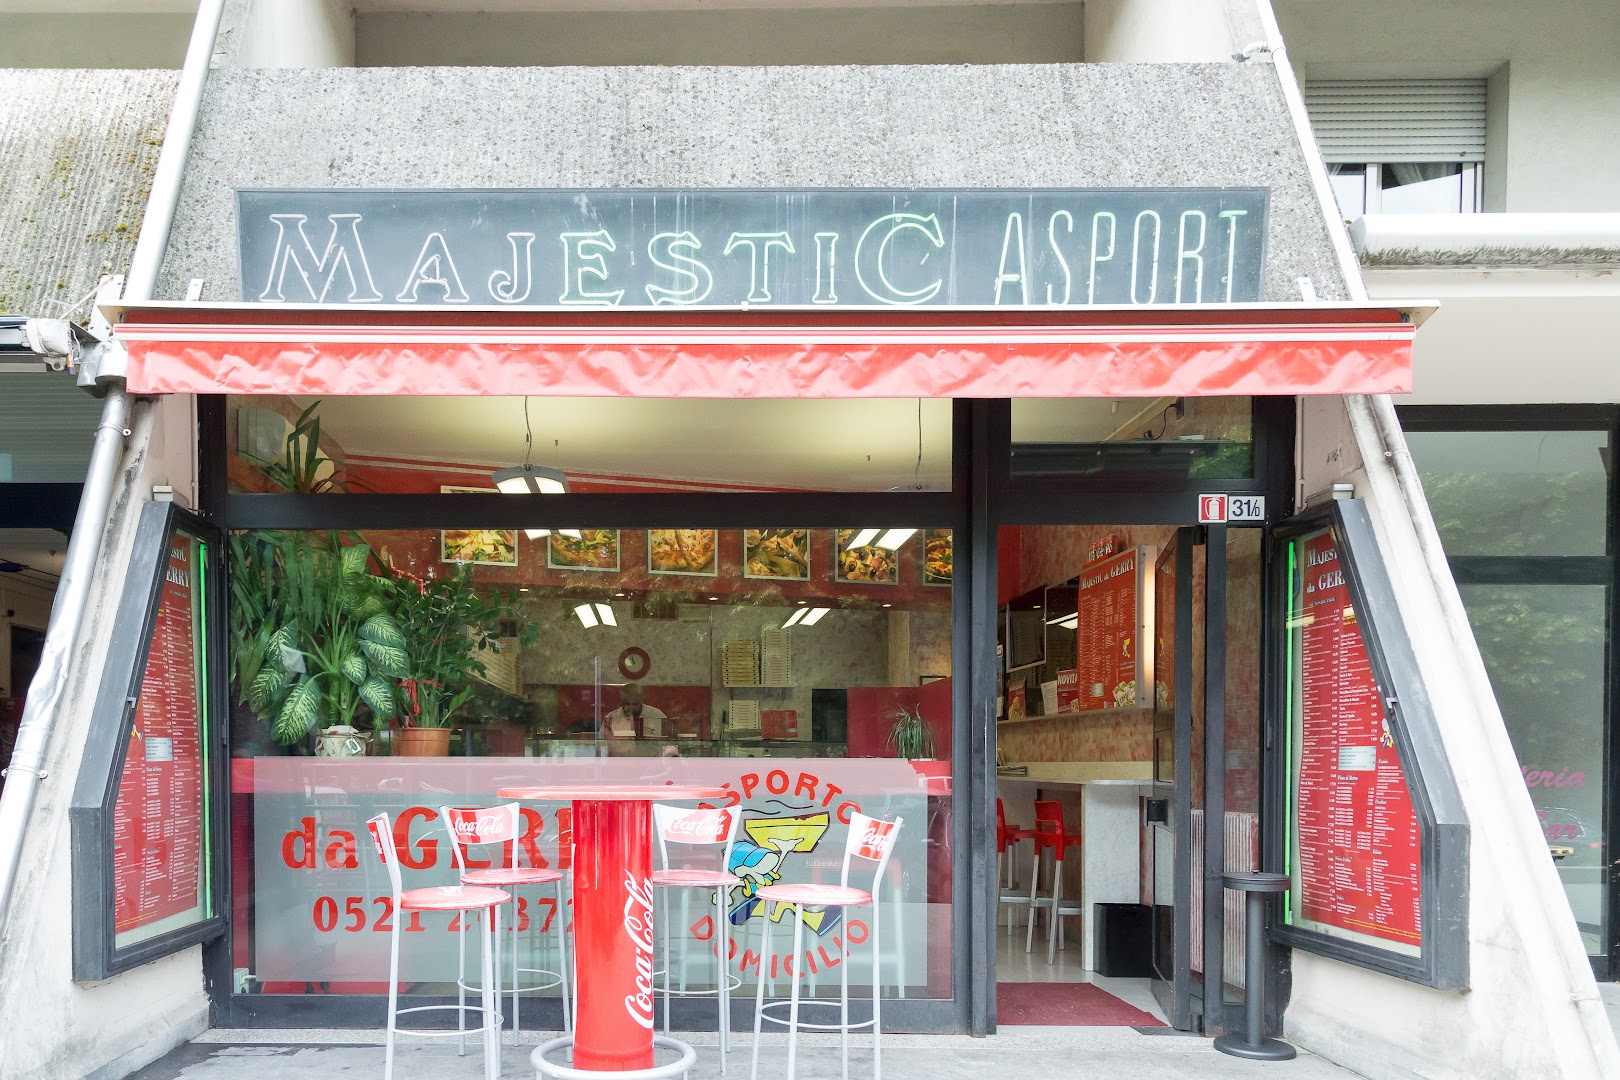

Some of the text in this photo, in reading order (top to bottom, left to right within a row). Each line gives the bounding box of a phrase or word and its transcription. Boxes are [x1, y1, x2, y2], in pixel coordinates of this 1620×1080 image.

[258, 209, 1248, 305] MAJESTIC ASPORT
[1110, 556, 1135, 578] GERRY
[1307, 582, 1316, 594] da
[281, 816, 359, 870] da
[455, 813, 505, 837] Coca-Cola
[623, 868, 654, 1030] Coca-Cola
